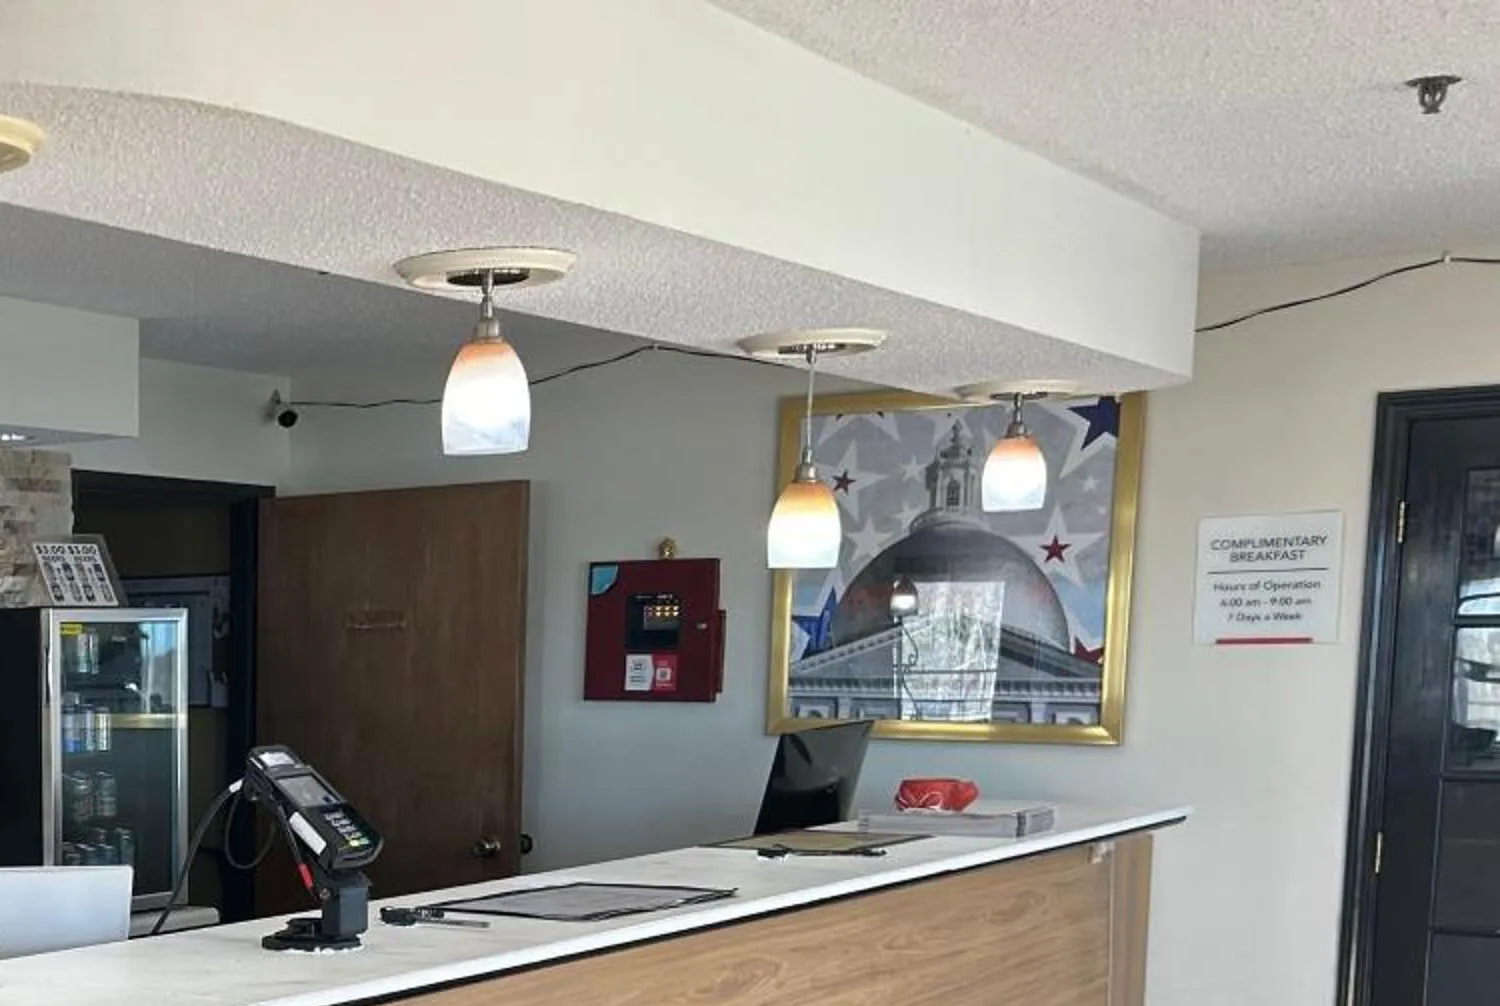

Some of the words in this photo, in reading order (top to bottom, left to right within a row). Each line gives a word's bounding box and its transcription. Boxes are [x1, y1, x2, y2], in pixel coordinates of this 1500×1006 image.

[1210, 534, 1329, 551] COMPLIMENTARY
[1229, 549, 1307, 563] BREAKFAST
[1213, 582, 1245, 592] Hours
[1247, 579, 1261, 591] of
[1263, 579, 1321, 592] Operation
[1235, 611, 1260, 623] Days
[1272, 611, 1302, 621] Week
